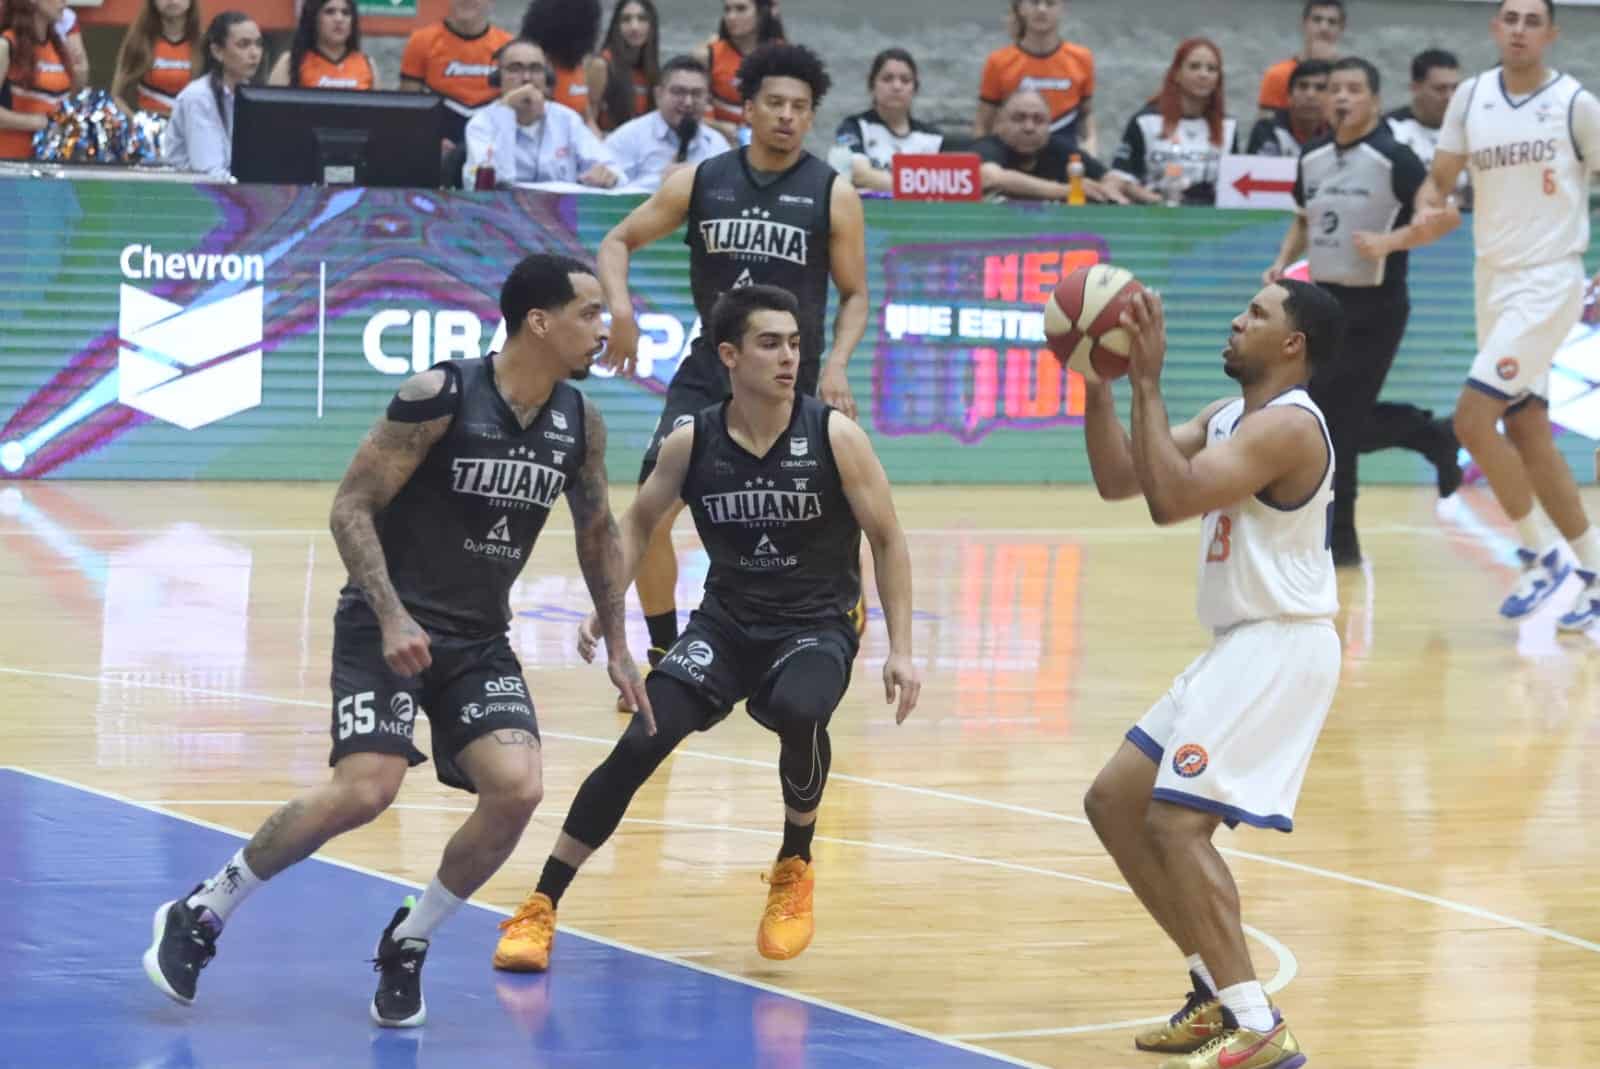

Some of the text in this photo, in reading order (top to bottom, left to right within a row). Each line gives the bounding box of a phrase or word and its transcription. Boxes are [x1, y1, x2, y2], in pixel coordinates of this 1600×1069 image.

[900, 168, 973, 195] BONUS
[1543, 168, 1557, 194] 6
[701, 219, 806, 264] TIJUANA
[120, 244, 264, 282] Chevron
[885, 304, 951, 340] QUE
[453, 458, 566, 508] TIJUANA
[702, 490, 821, 523] TIJUANA
[669, 653, 705, 682] MEGA
[338, 691, 375, 740] 55
